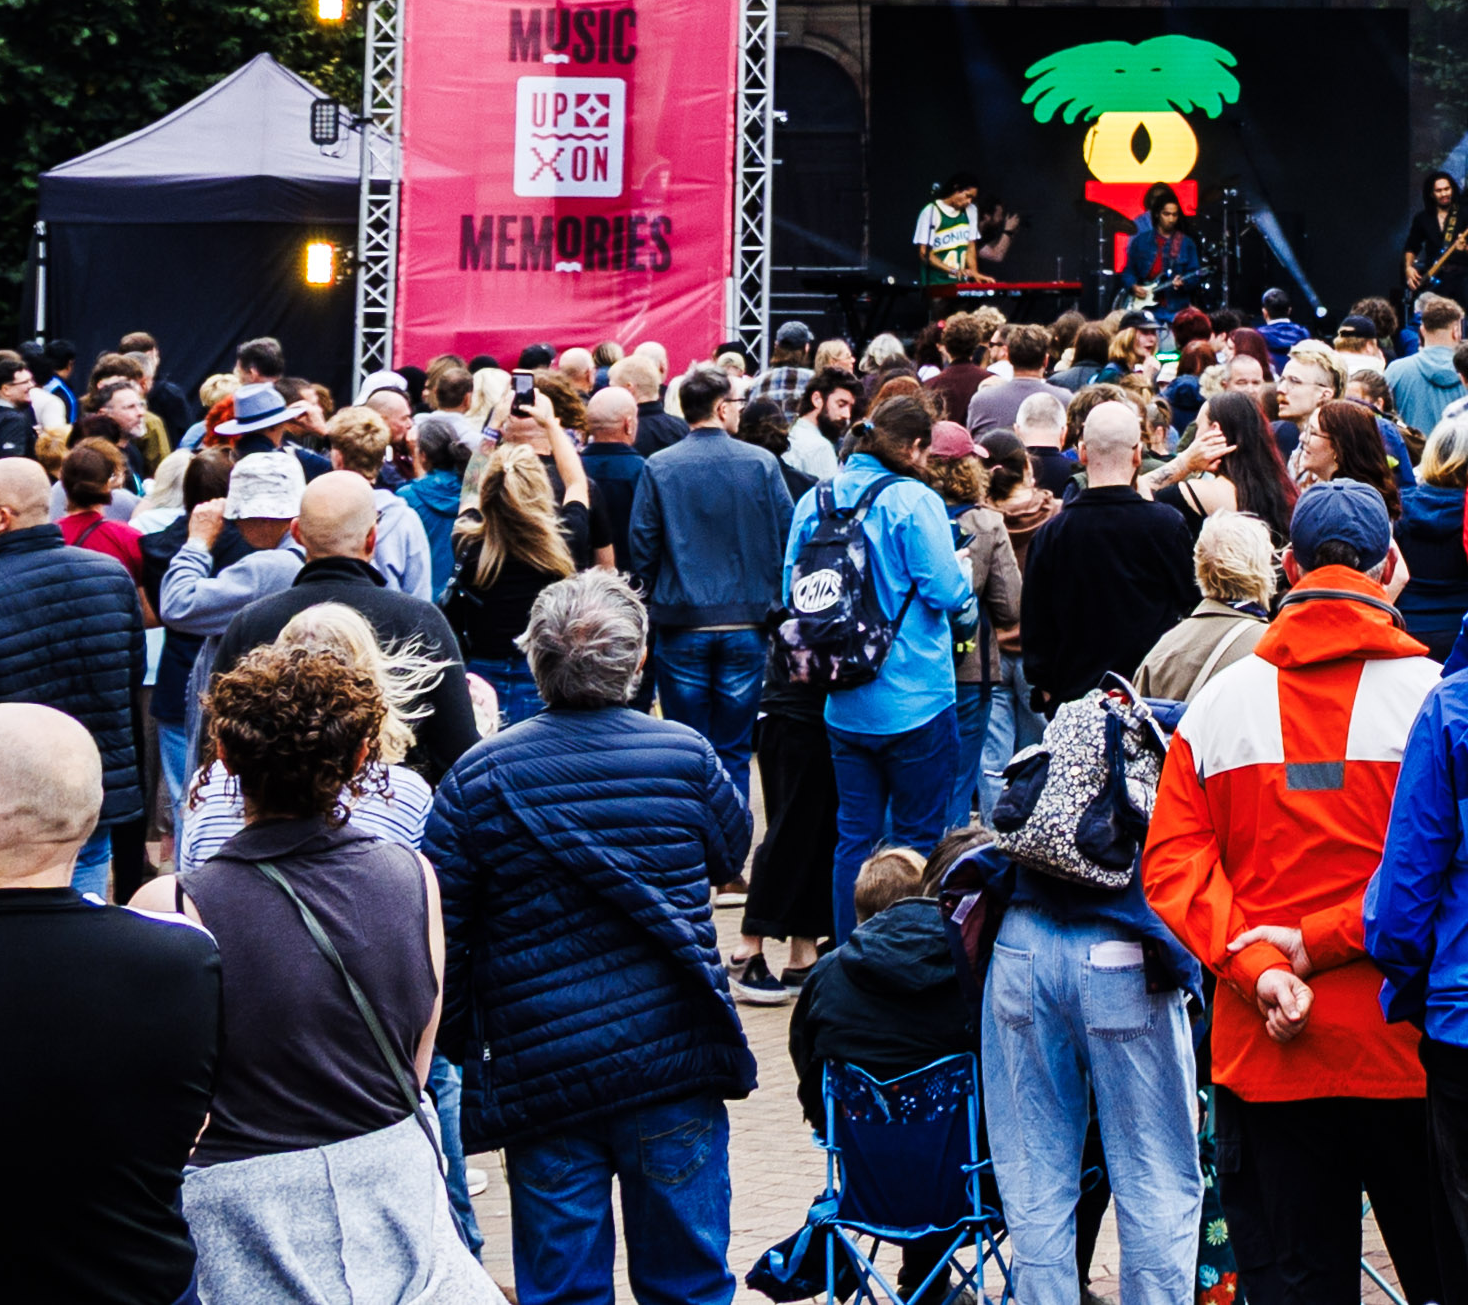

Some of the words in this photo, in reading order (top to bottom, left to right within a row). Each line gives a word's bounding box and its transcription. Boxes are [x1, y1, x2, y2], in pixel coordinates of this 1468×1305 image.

[508, 8, 637, 64] MUSIC
[532, 93, 568, 128] UP
[571, 146, 608, 182] ON
[458, 215, 673, 272] MEMORIES
